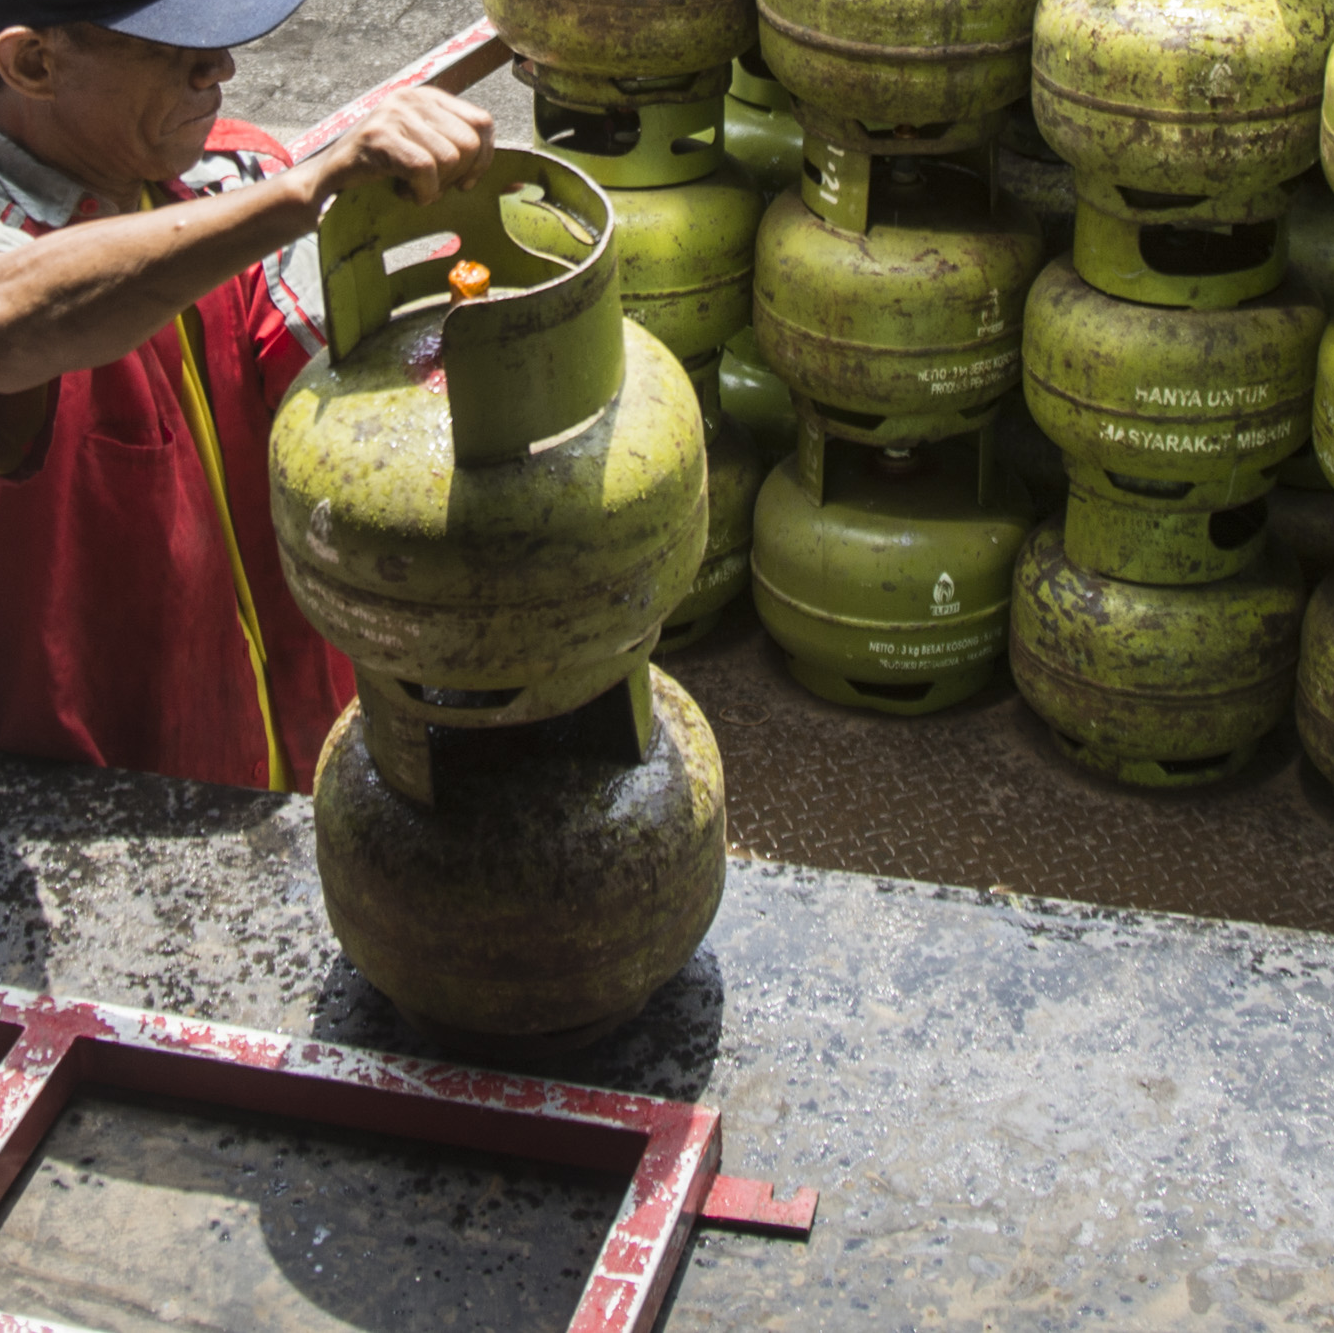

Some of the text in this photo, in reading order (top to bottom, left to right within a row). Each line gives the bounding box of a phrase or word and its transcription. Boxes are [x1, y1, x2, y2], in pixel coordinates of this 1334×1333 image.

[1207, 383, 1269, 408] UNTUK
[869, 641, 895, 655] NETTO
[921, 643, 945, 656] BERAT
[946, 636, 979, 653] KOSONG
